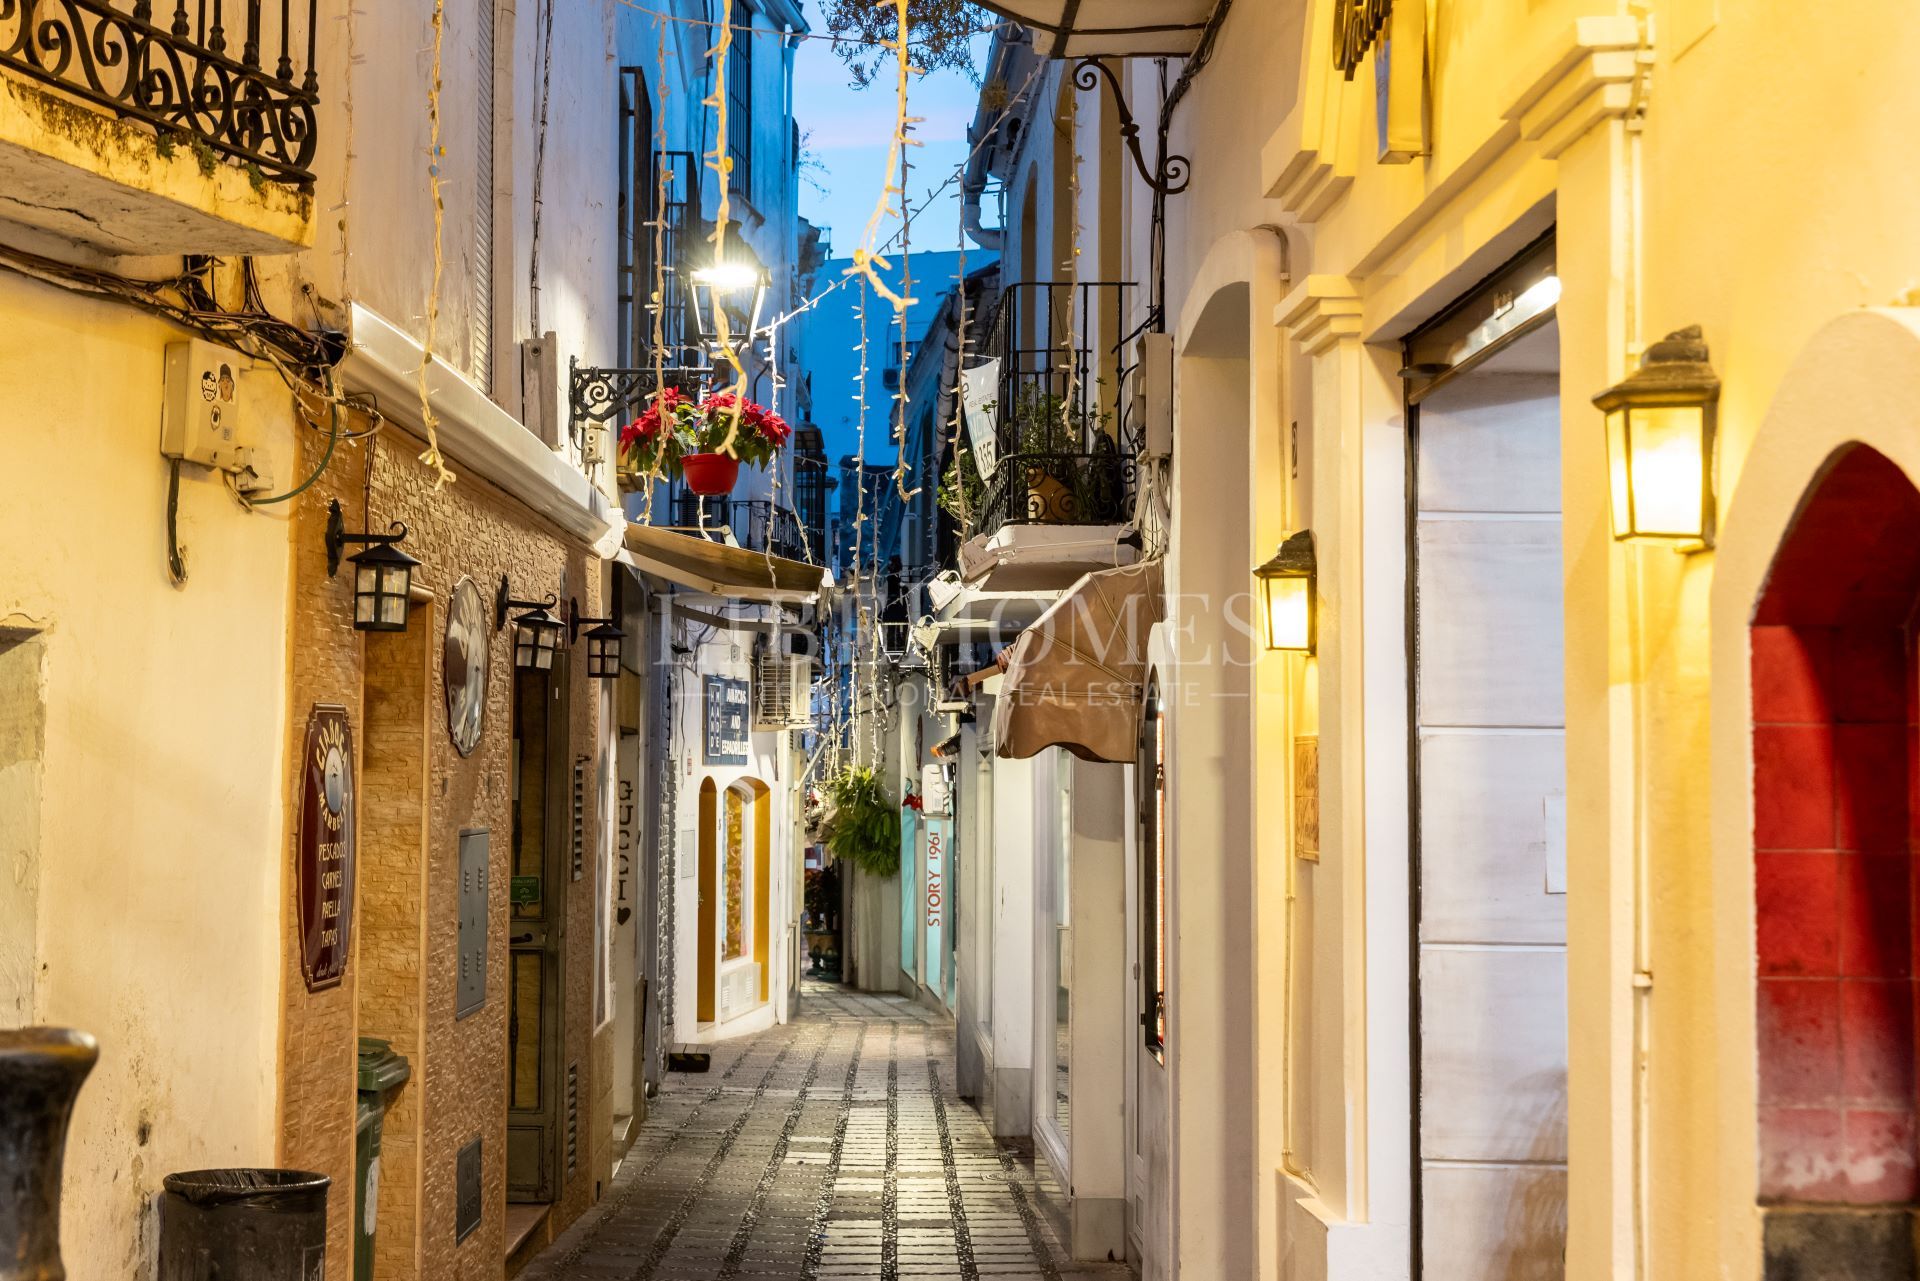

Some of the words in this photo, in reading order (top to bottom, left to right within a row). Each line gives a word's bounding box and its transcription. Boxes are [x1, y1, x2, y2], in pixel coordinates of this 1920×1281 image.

[319, 842, 346, 861] PESCADOS
[928, 832, 941, 860] 1961
[322, 870, 342, 889] CARNES
[927, 870, 941, 927] STORY
[322, 899, 341, 919] PAELLA
[321, 928, 338, 948] TAPAS
